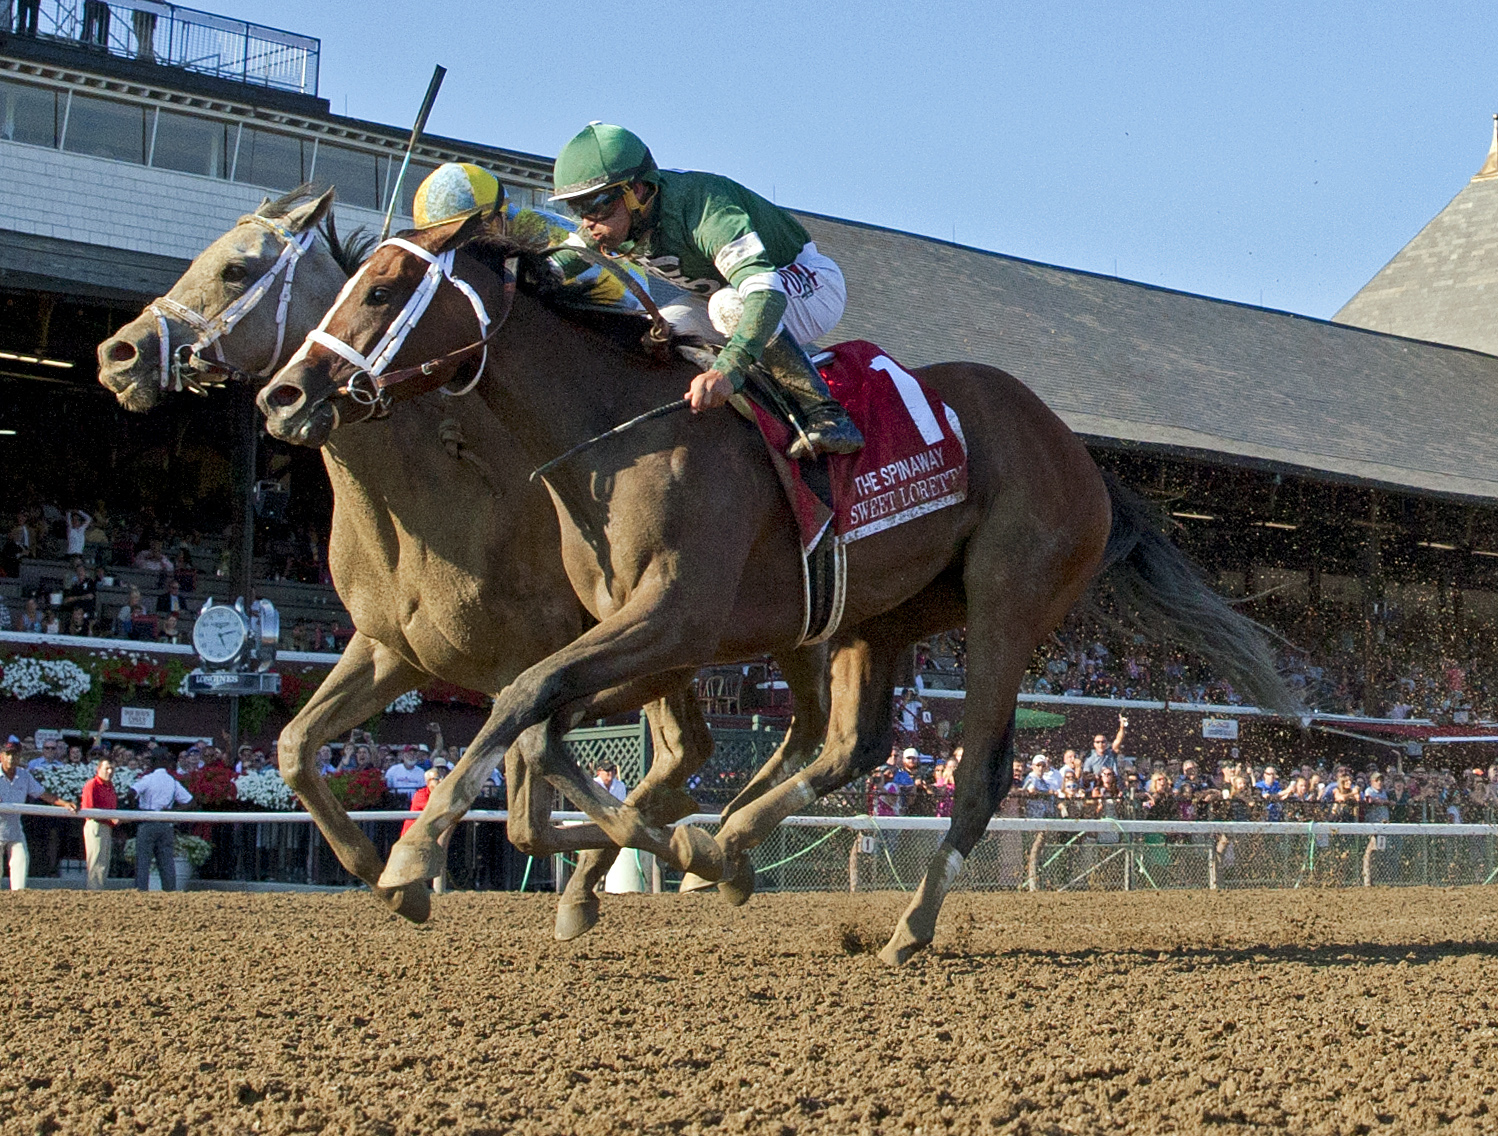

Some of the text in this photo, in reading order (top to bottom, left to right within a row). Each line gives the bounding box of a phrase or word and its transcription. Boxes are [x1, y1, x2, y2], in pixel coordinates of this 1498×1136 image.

[869, 355, 945, 446] 1
[850, 466, 963, 525] SWEET LORETT
[855, 447, 945, 497] THE SPINAWAY
[195, 675, 240, 684] LONGINES
